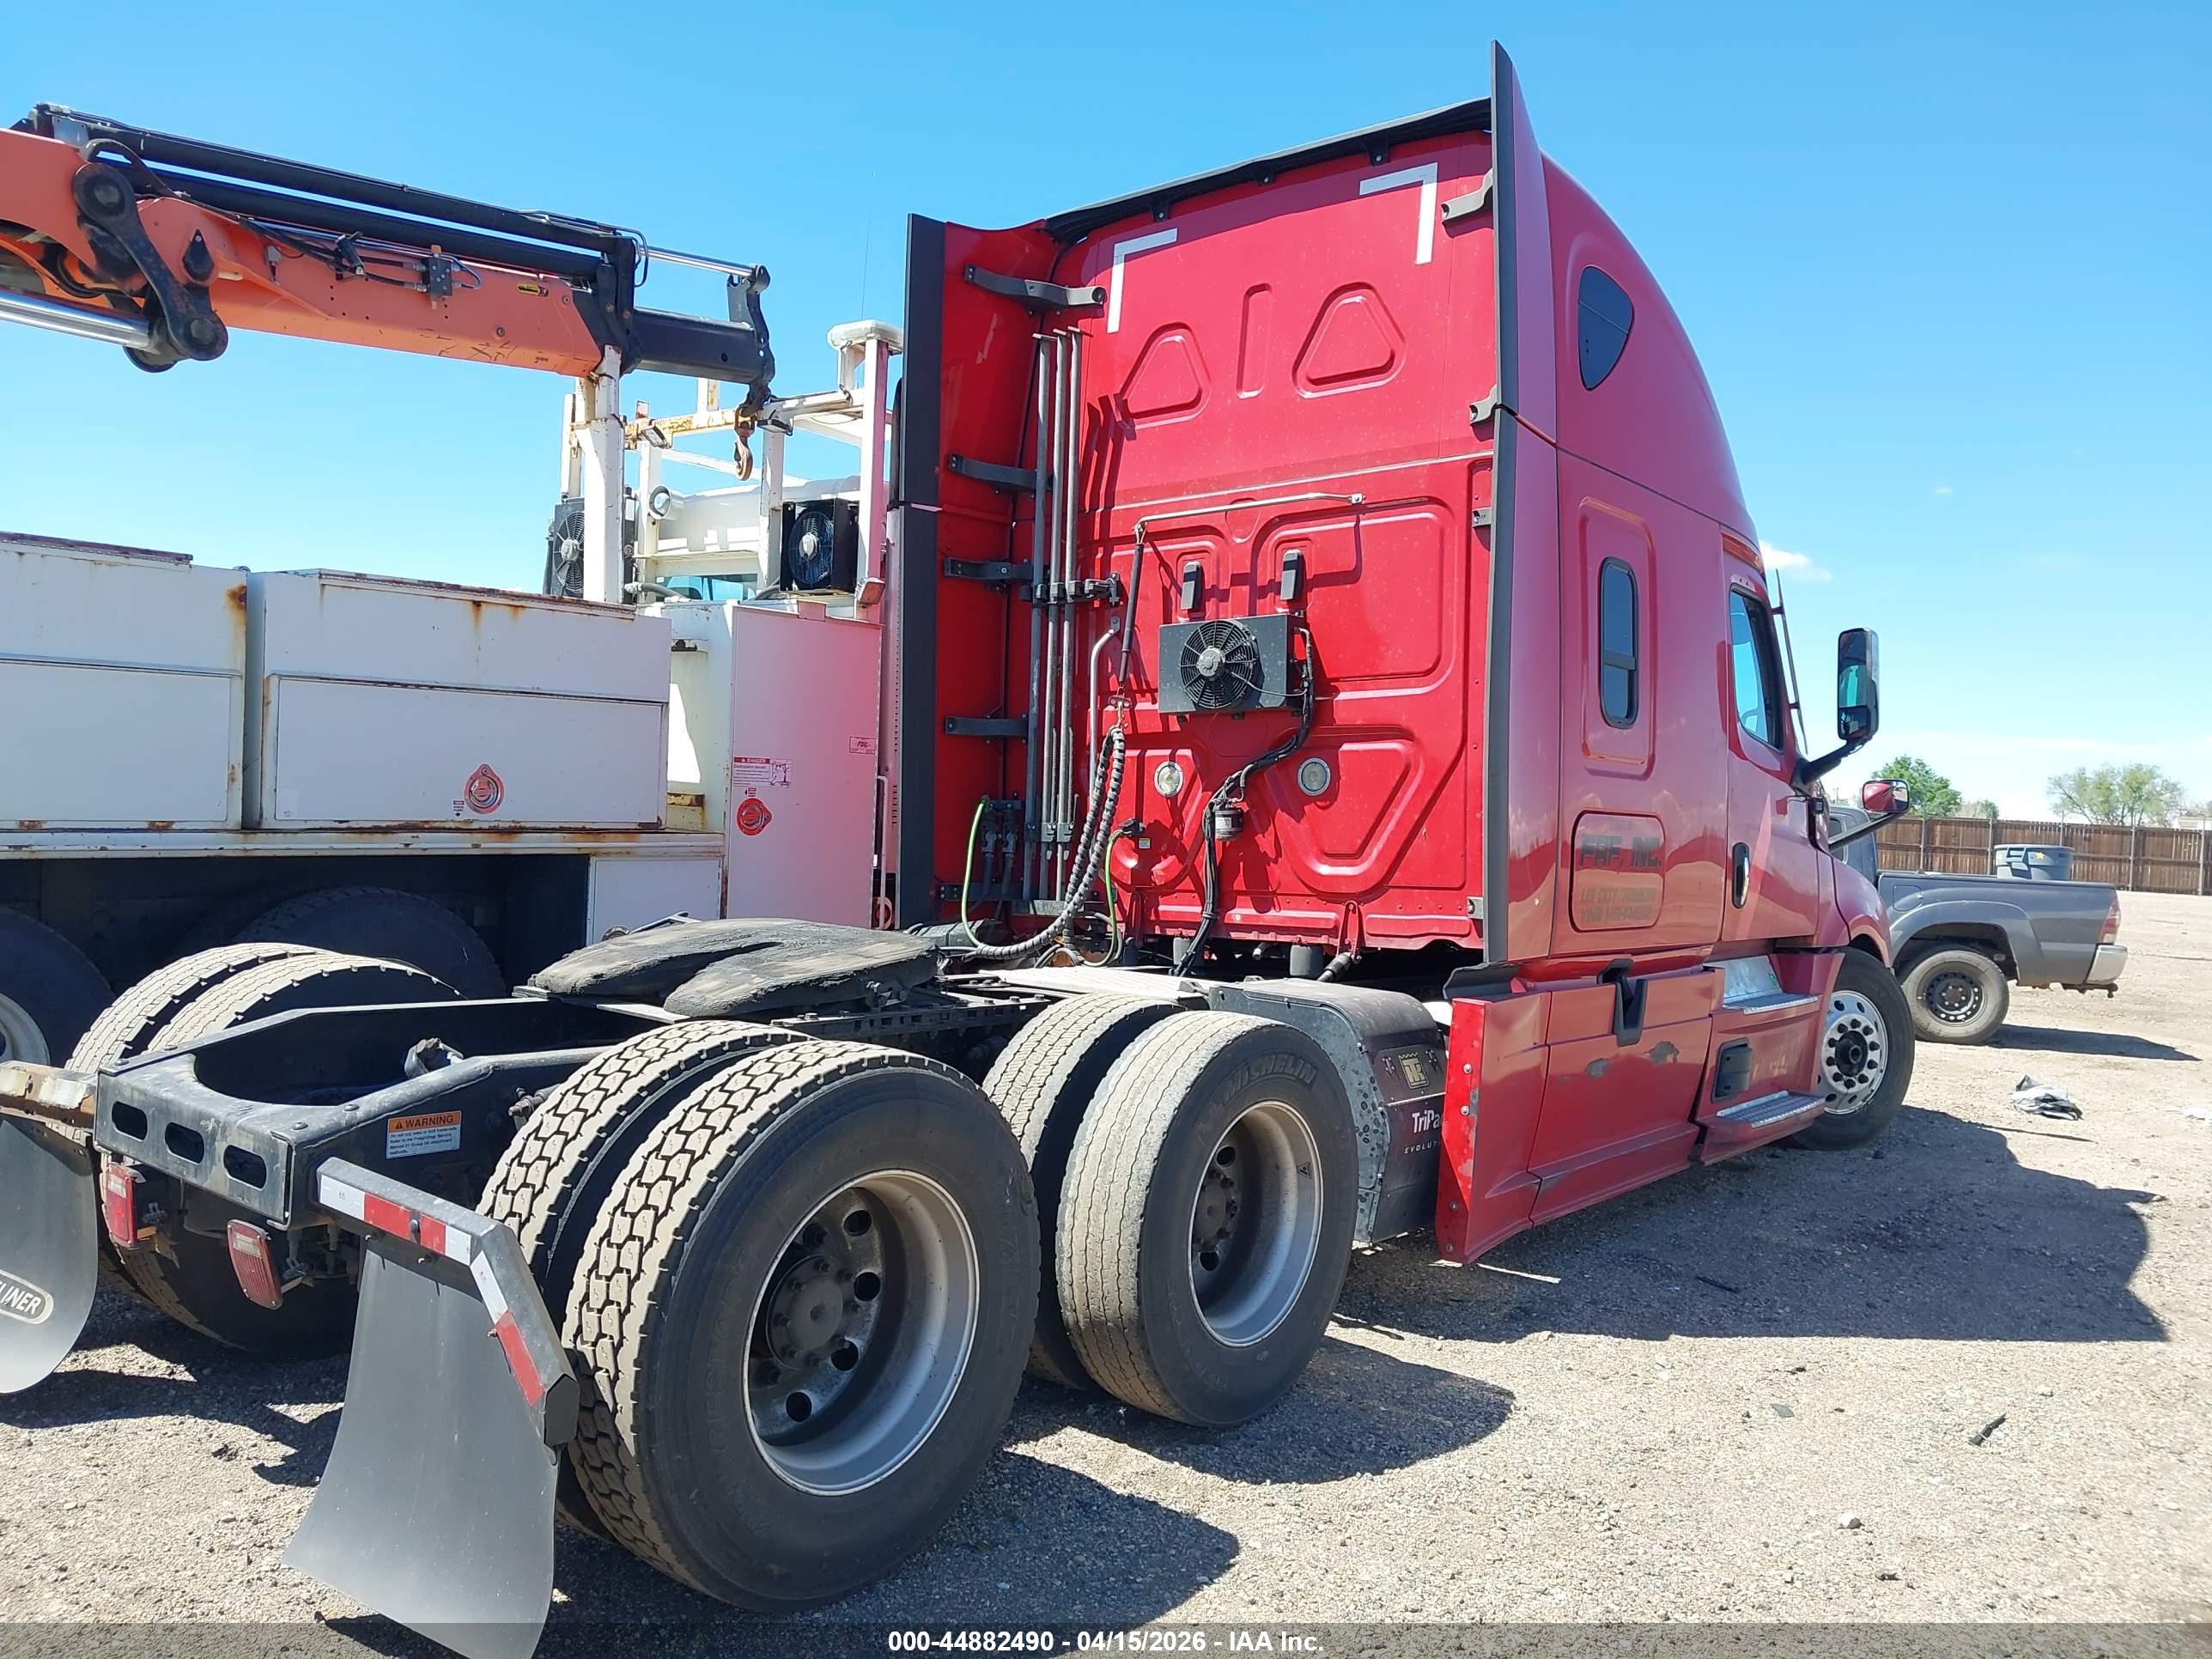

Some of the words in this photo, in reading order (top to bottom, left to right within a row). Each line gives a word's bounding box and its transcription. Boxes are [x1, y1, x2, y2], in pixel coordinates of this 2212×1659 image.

[1223, 1054, 1317, 1104] MICHELIN
[404, 1115, 453, 1128] WARNING
[1412, 1109, 1443, 1133] TriPa
